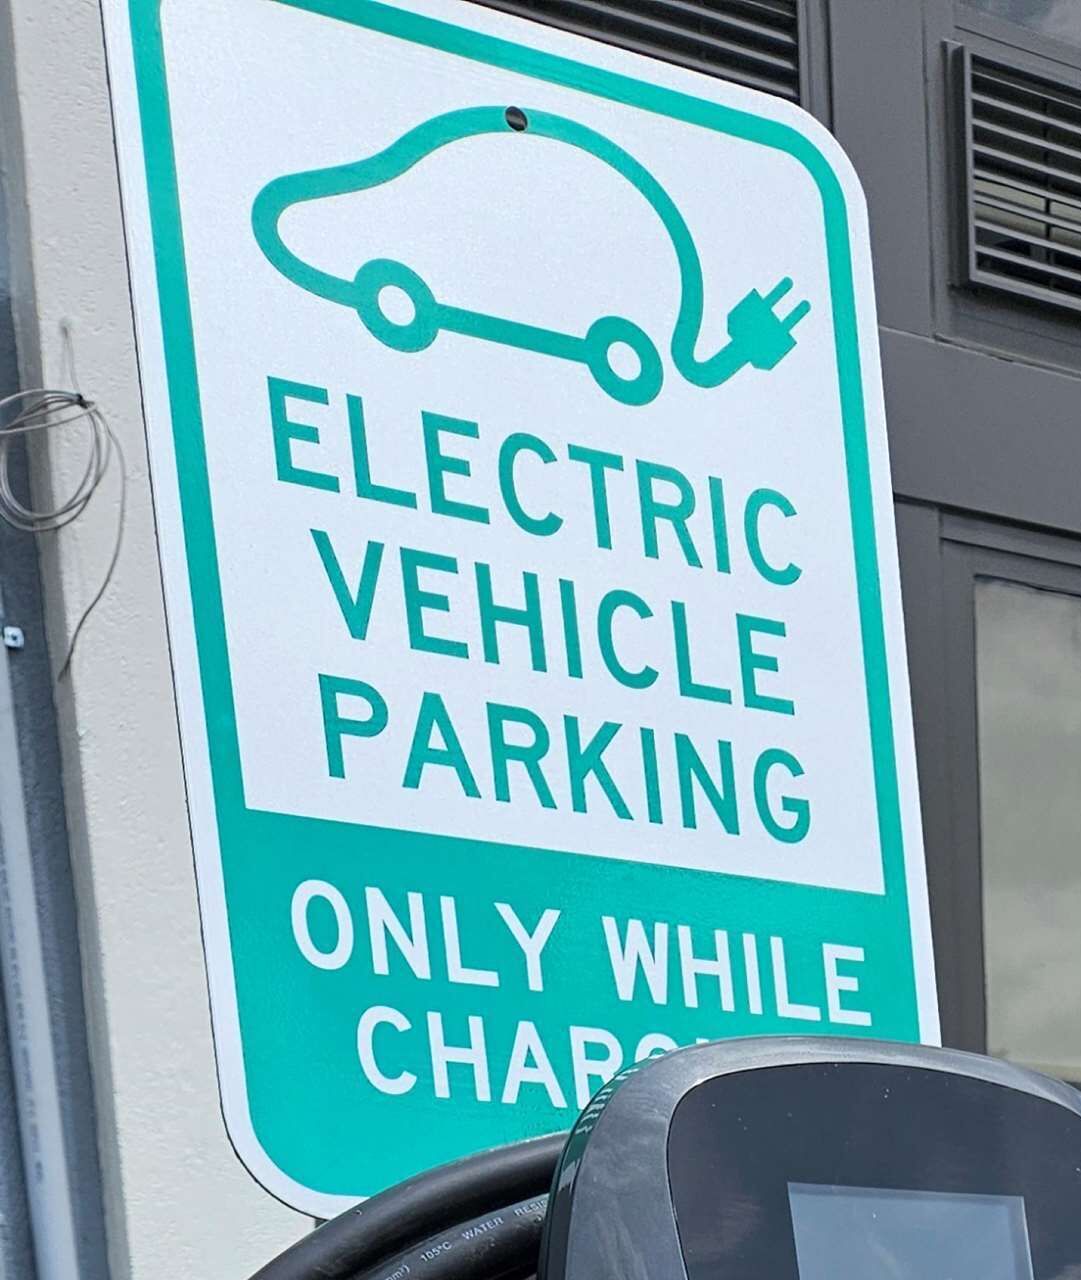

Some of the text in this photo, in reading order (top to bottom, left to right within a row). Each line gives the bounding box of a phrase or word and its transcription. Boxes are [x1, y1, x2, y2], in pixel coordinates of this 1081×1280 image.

[268, 376, 802, 586] ELECTRIC
[311, 529, 795, 716] VEHICLE
[318, 674, 811, 845] PARKING
[291, 879, 872, 1026] ONLY WHILE
[357, 1006, 709, 1110] CHAR
[462, 1217, 505, 1241] WATER
